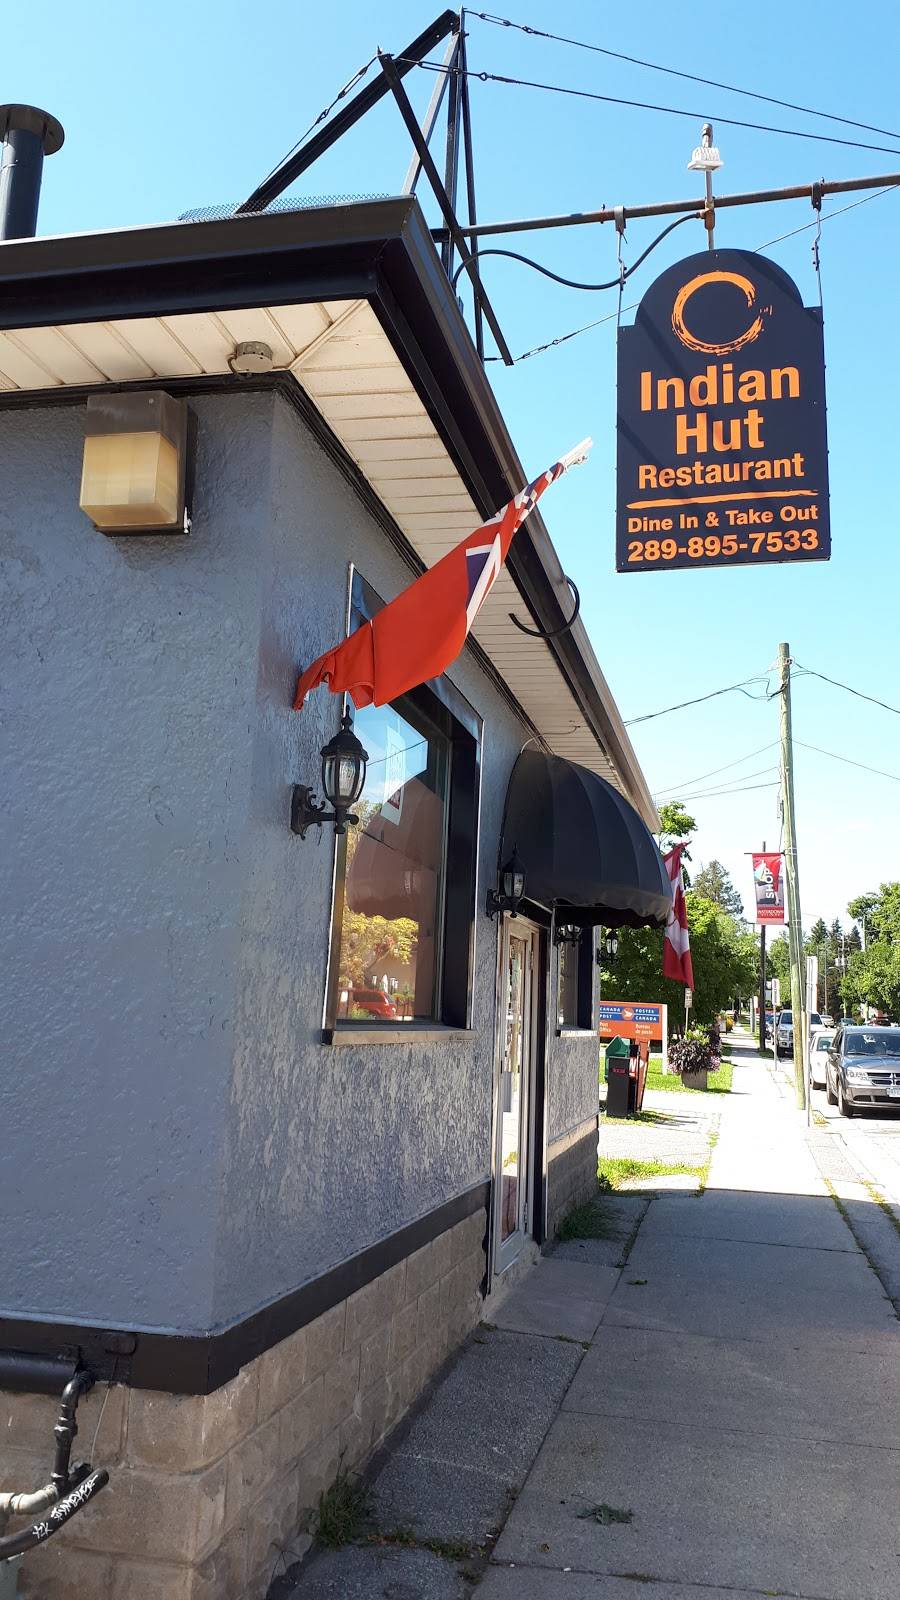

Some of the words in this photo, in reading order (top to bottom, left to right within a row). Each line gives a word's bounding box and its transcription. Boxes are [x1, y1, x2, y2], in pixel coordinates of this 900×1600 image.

[640, 363, 800, 411] Indian
[676, 409, 765, 455] Hut
[638, 452, 805, 490] Restaurant
[627, 513, 673, 533] Dine
[679, 512, 699, 530] In
[705, 511, 720, 527] &
[726, 508, 774, 526] Take
[780, 504, 819, 522] Out
[627, 528, 819, 562] 289-895-7533
[765, 868, 774, 899] SHOP
